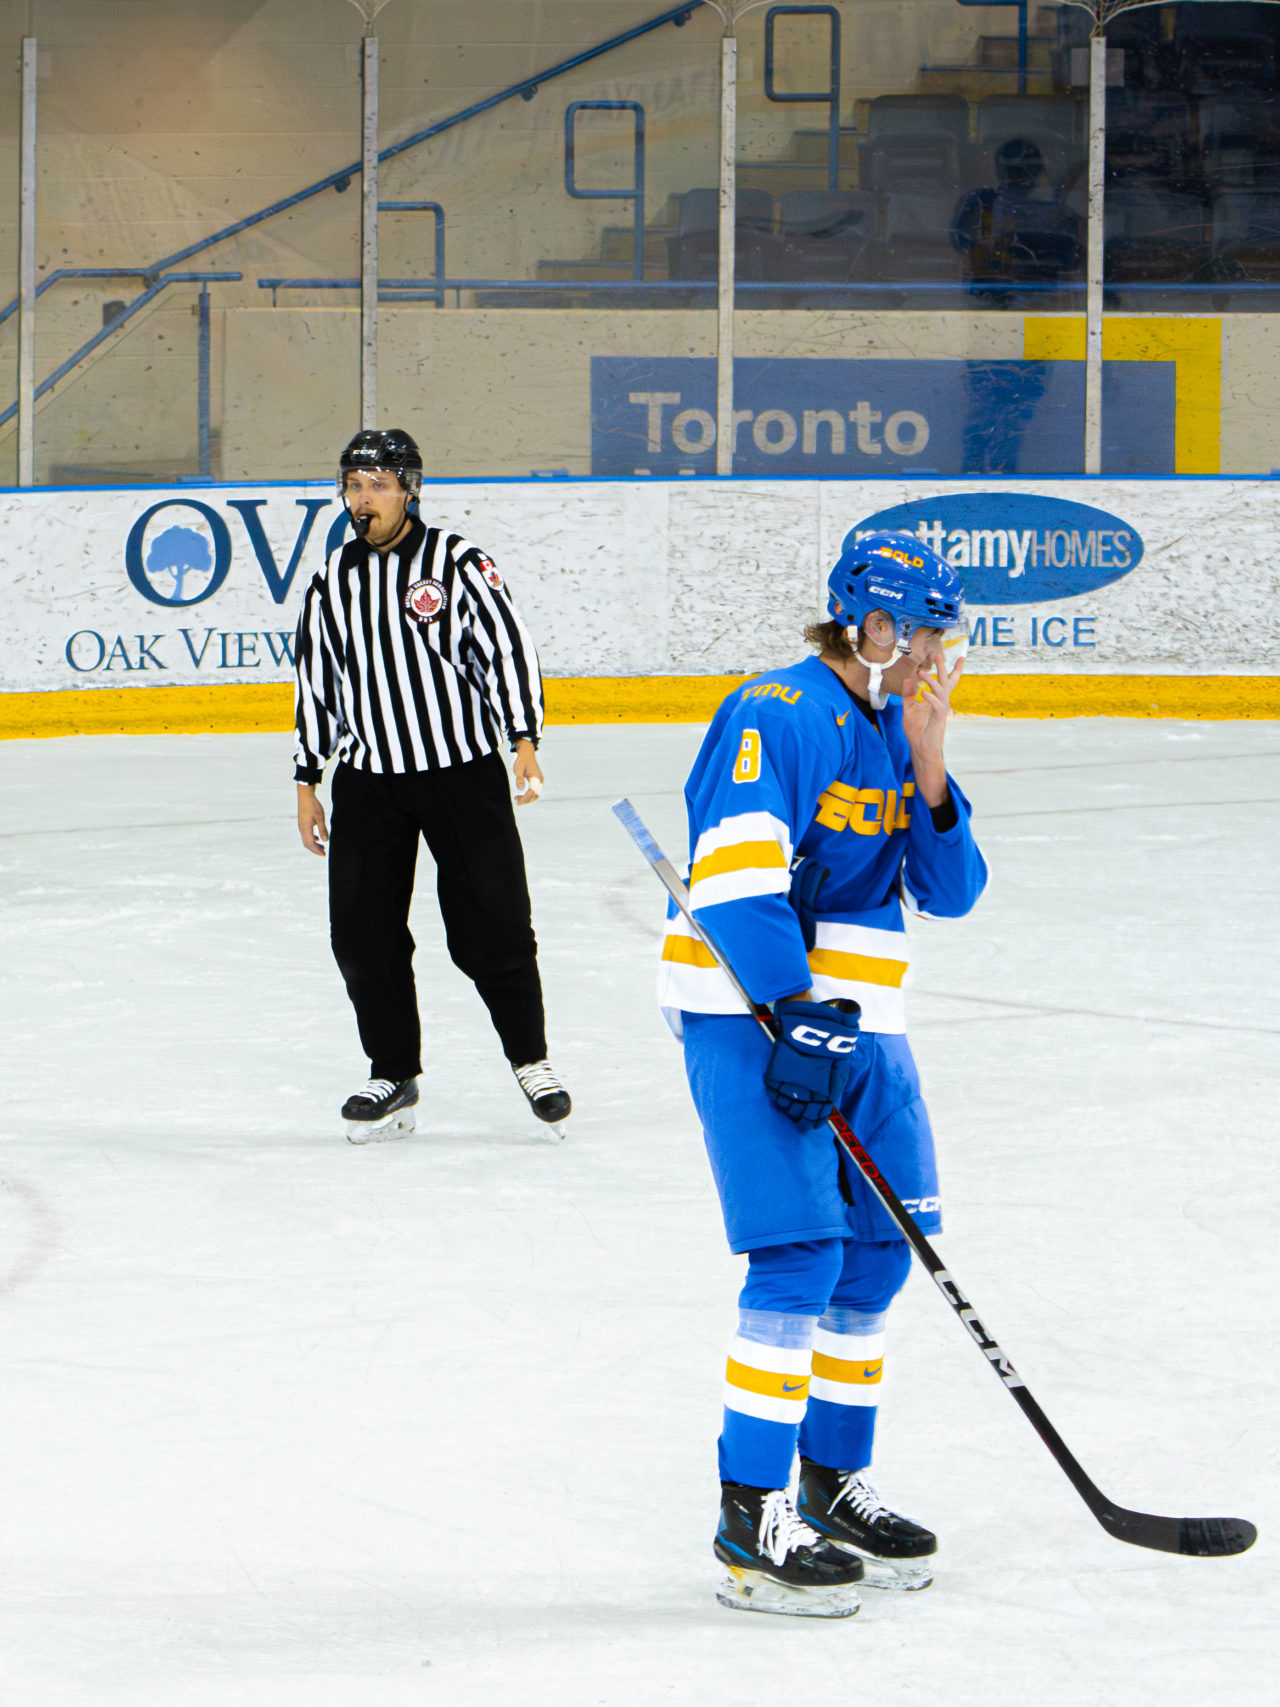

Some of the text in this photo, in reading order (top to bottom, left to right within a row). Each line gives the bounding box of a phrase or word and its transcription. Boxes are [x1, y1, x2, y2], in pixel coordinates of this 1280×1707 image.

[628, 392, 930, 455] Toronto
[880, 546, 925, 569] BOLD
[869, 586, 903, 600] CCM
[1031, 617, 1096, 647] ICE
[65, 629, 168, 672] OAK
[742, 683, 803, 705] TMU
[732, 728, 762, 784] 8
[933, 1269, 1026, 1389] CCM
